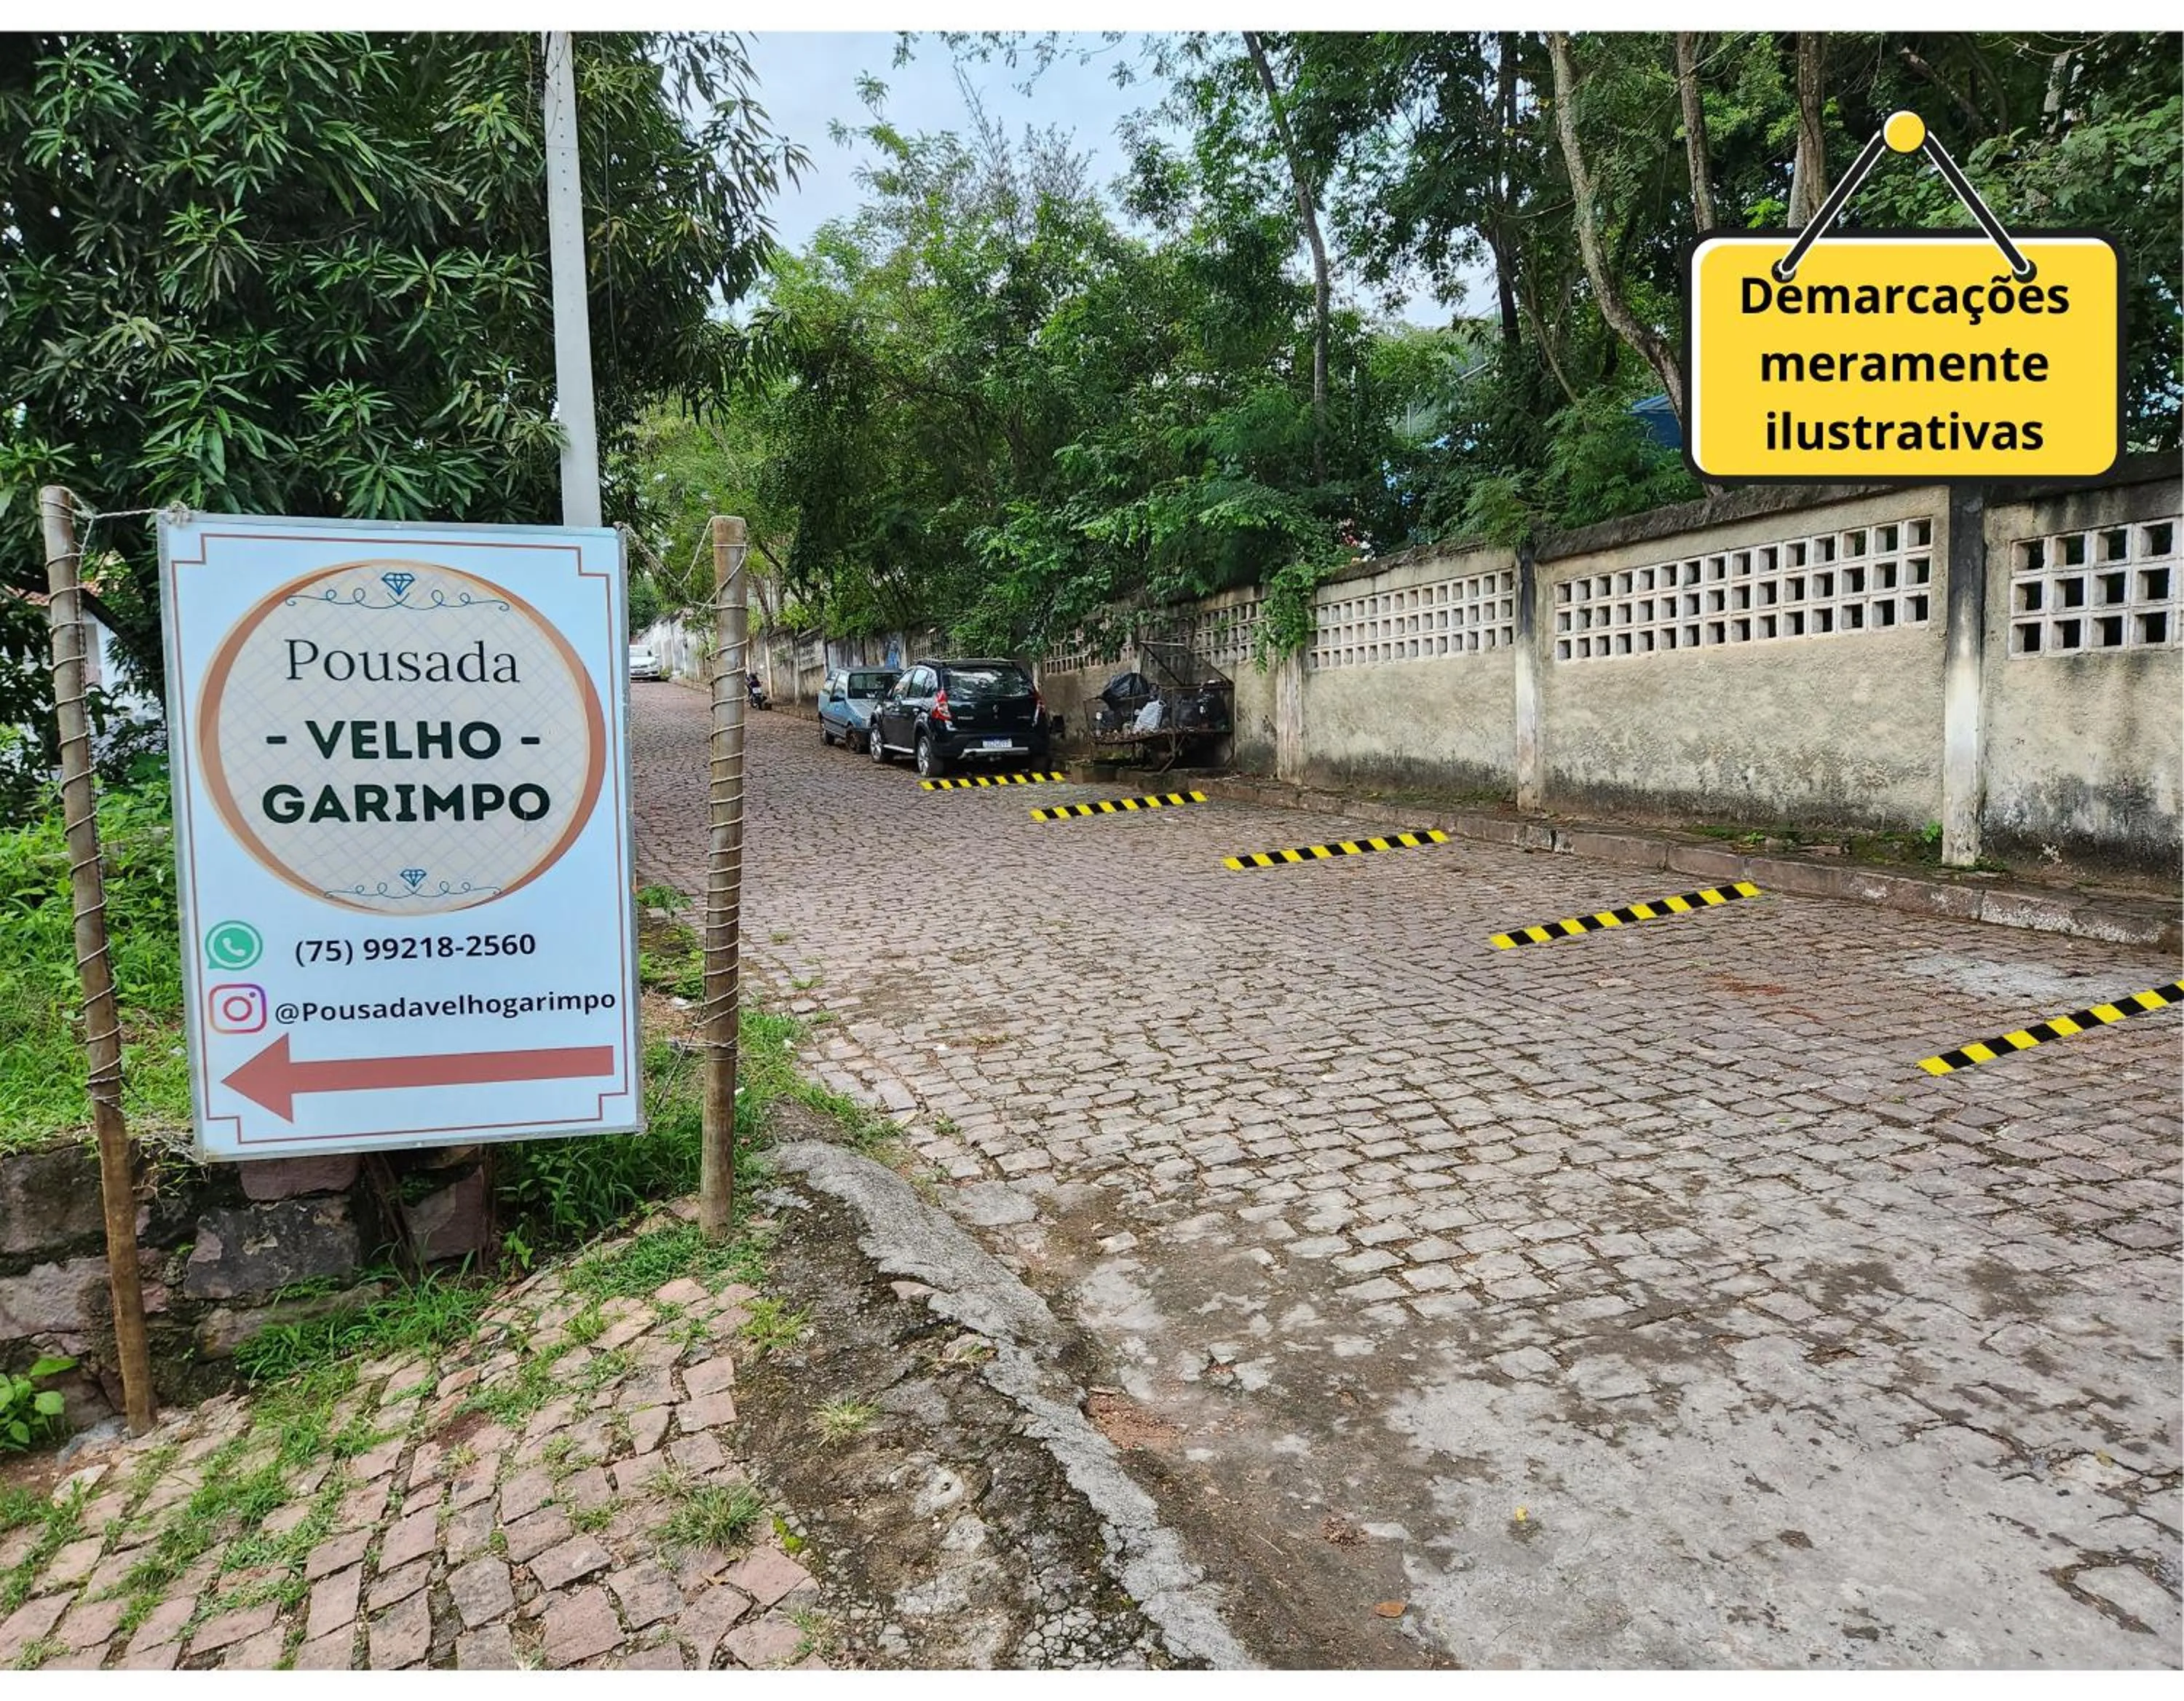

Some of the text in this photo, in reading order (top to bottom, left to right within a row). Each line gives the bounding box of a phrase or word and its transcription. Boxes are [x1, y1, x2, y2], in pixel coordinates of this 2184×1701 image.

[284, 639, 521, 684] Pousada
[304, 720, 502, 759] VELHO
[262, 782, 551, 824] GARIMPO
[295, 933, 537, 968] (75) 99218-2560
[274, 990, 616, 1025] @Pousadavelhogarimpo
